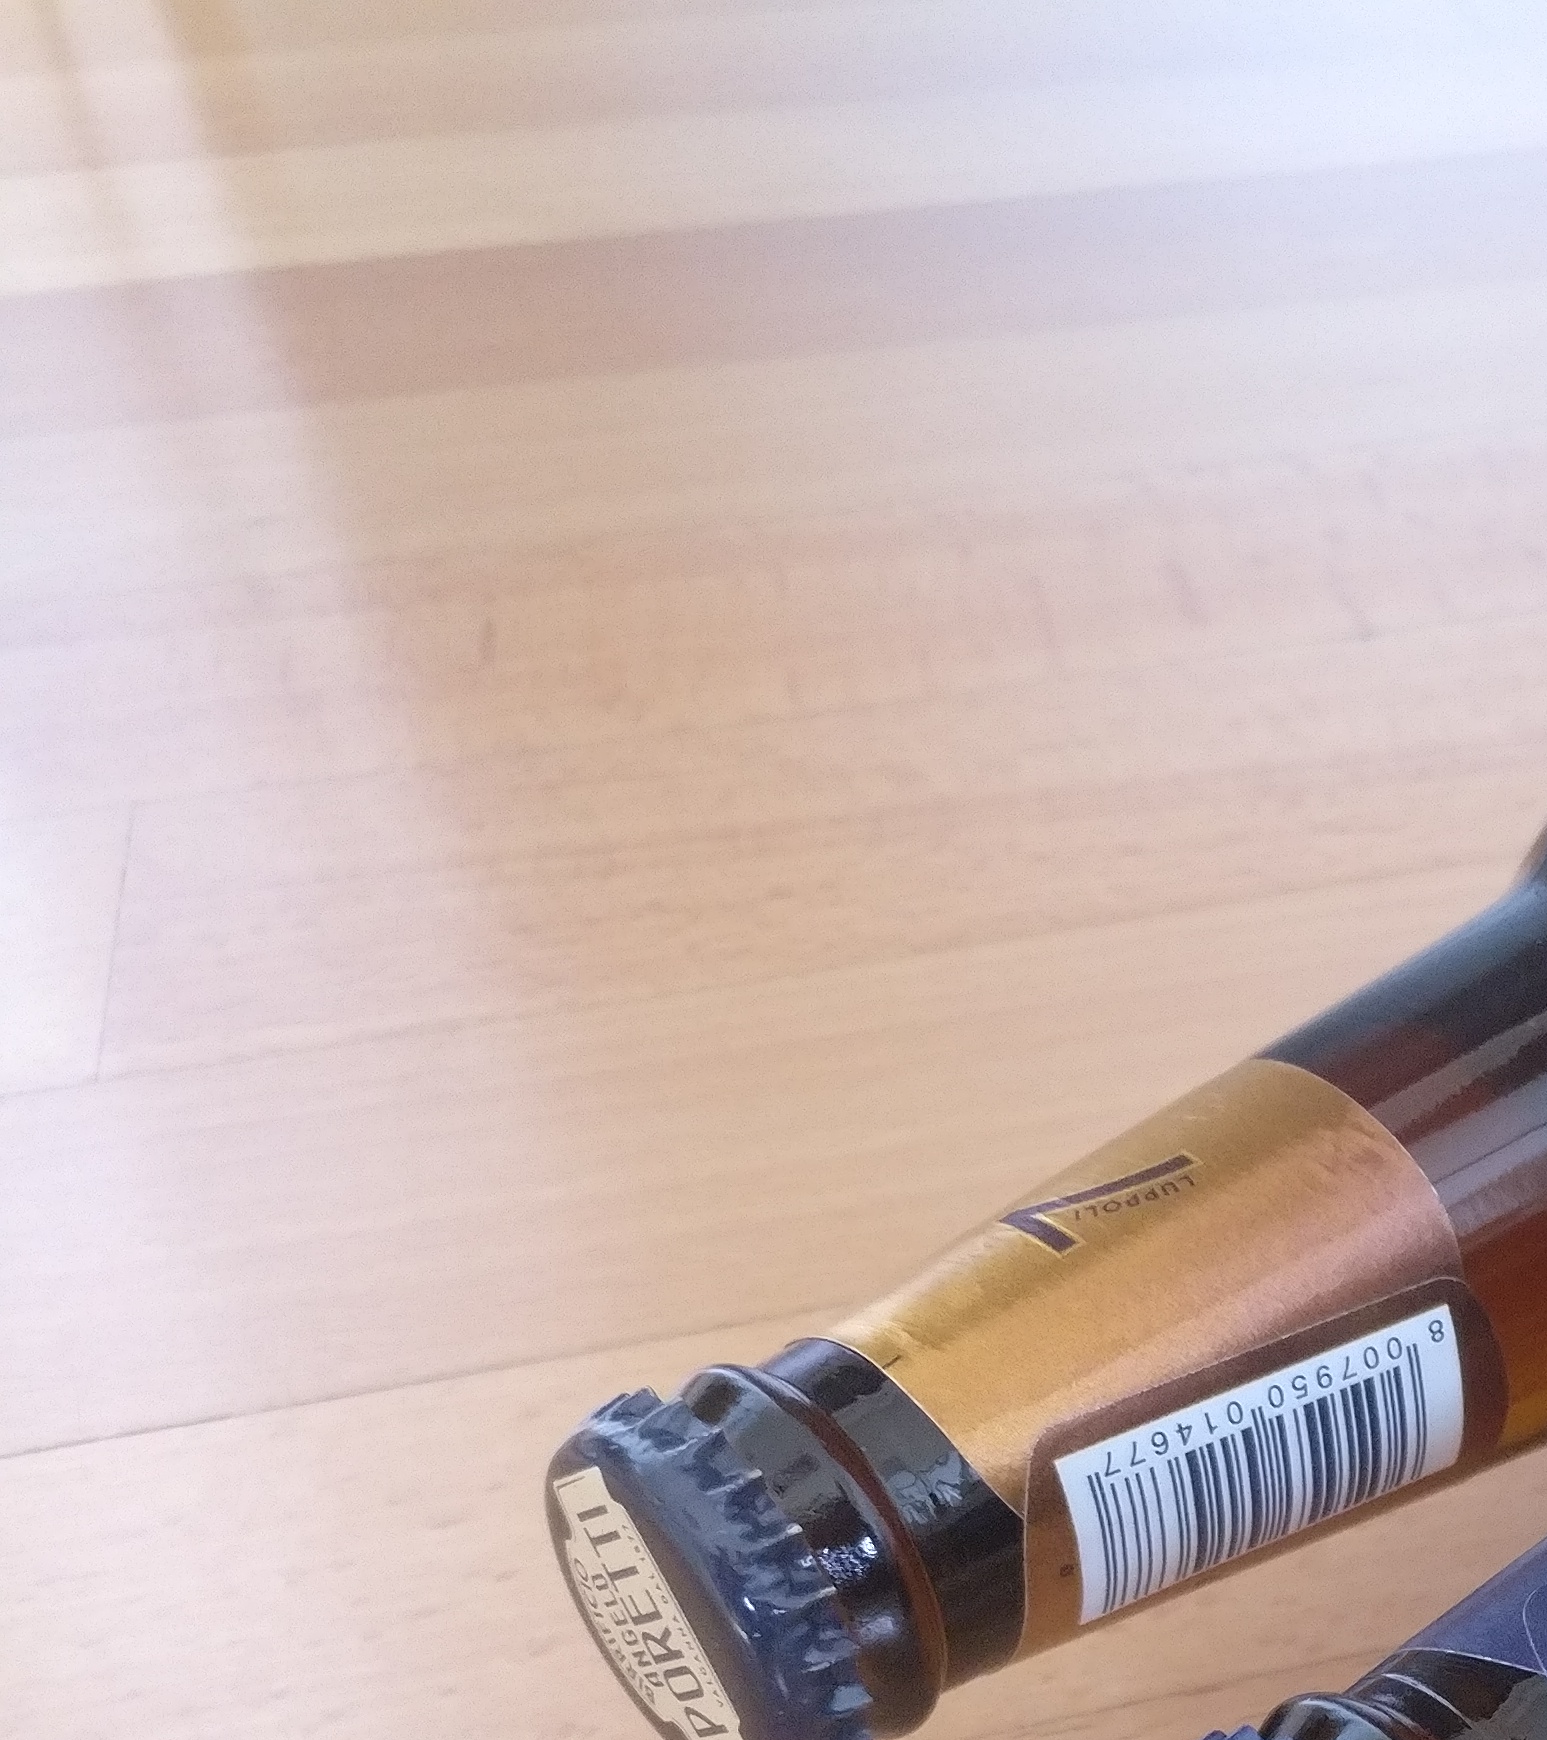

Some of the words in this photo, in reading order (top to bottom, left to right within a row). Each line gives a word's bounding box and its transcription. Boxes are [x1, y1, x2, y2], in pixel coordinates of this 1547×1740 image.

[1072, 1177, 1198, 1222] LUPPOLI
[1427, 1319, 1446, 1344] 8
[1268, 1335, 1403, 1410] 007950
[1102, 1400, 1246, 1479] 014677
[577, 1504, 729, 1738] PORETTI
[591, 1574, 665, 1688] ANGELO
